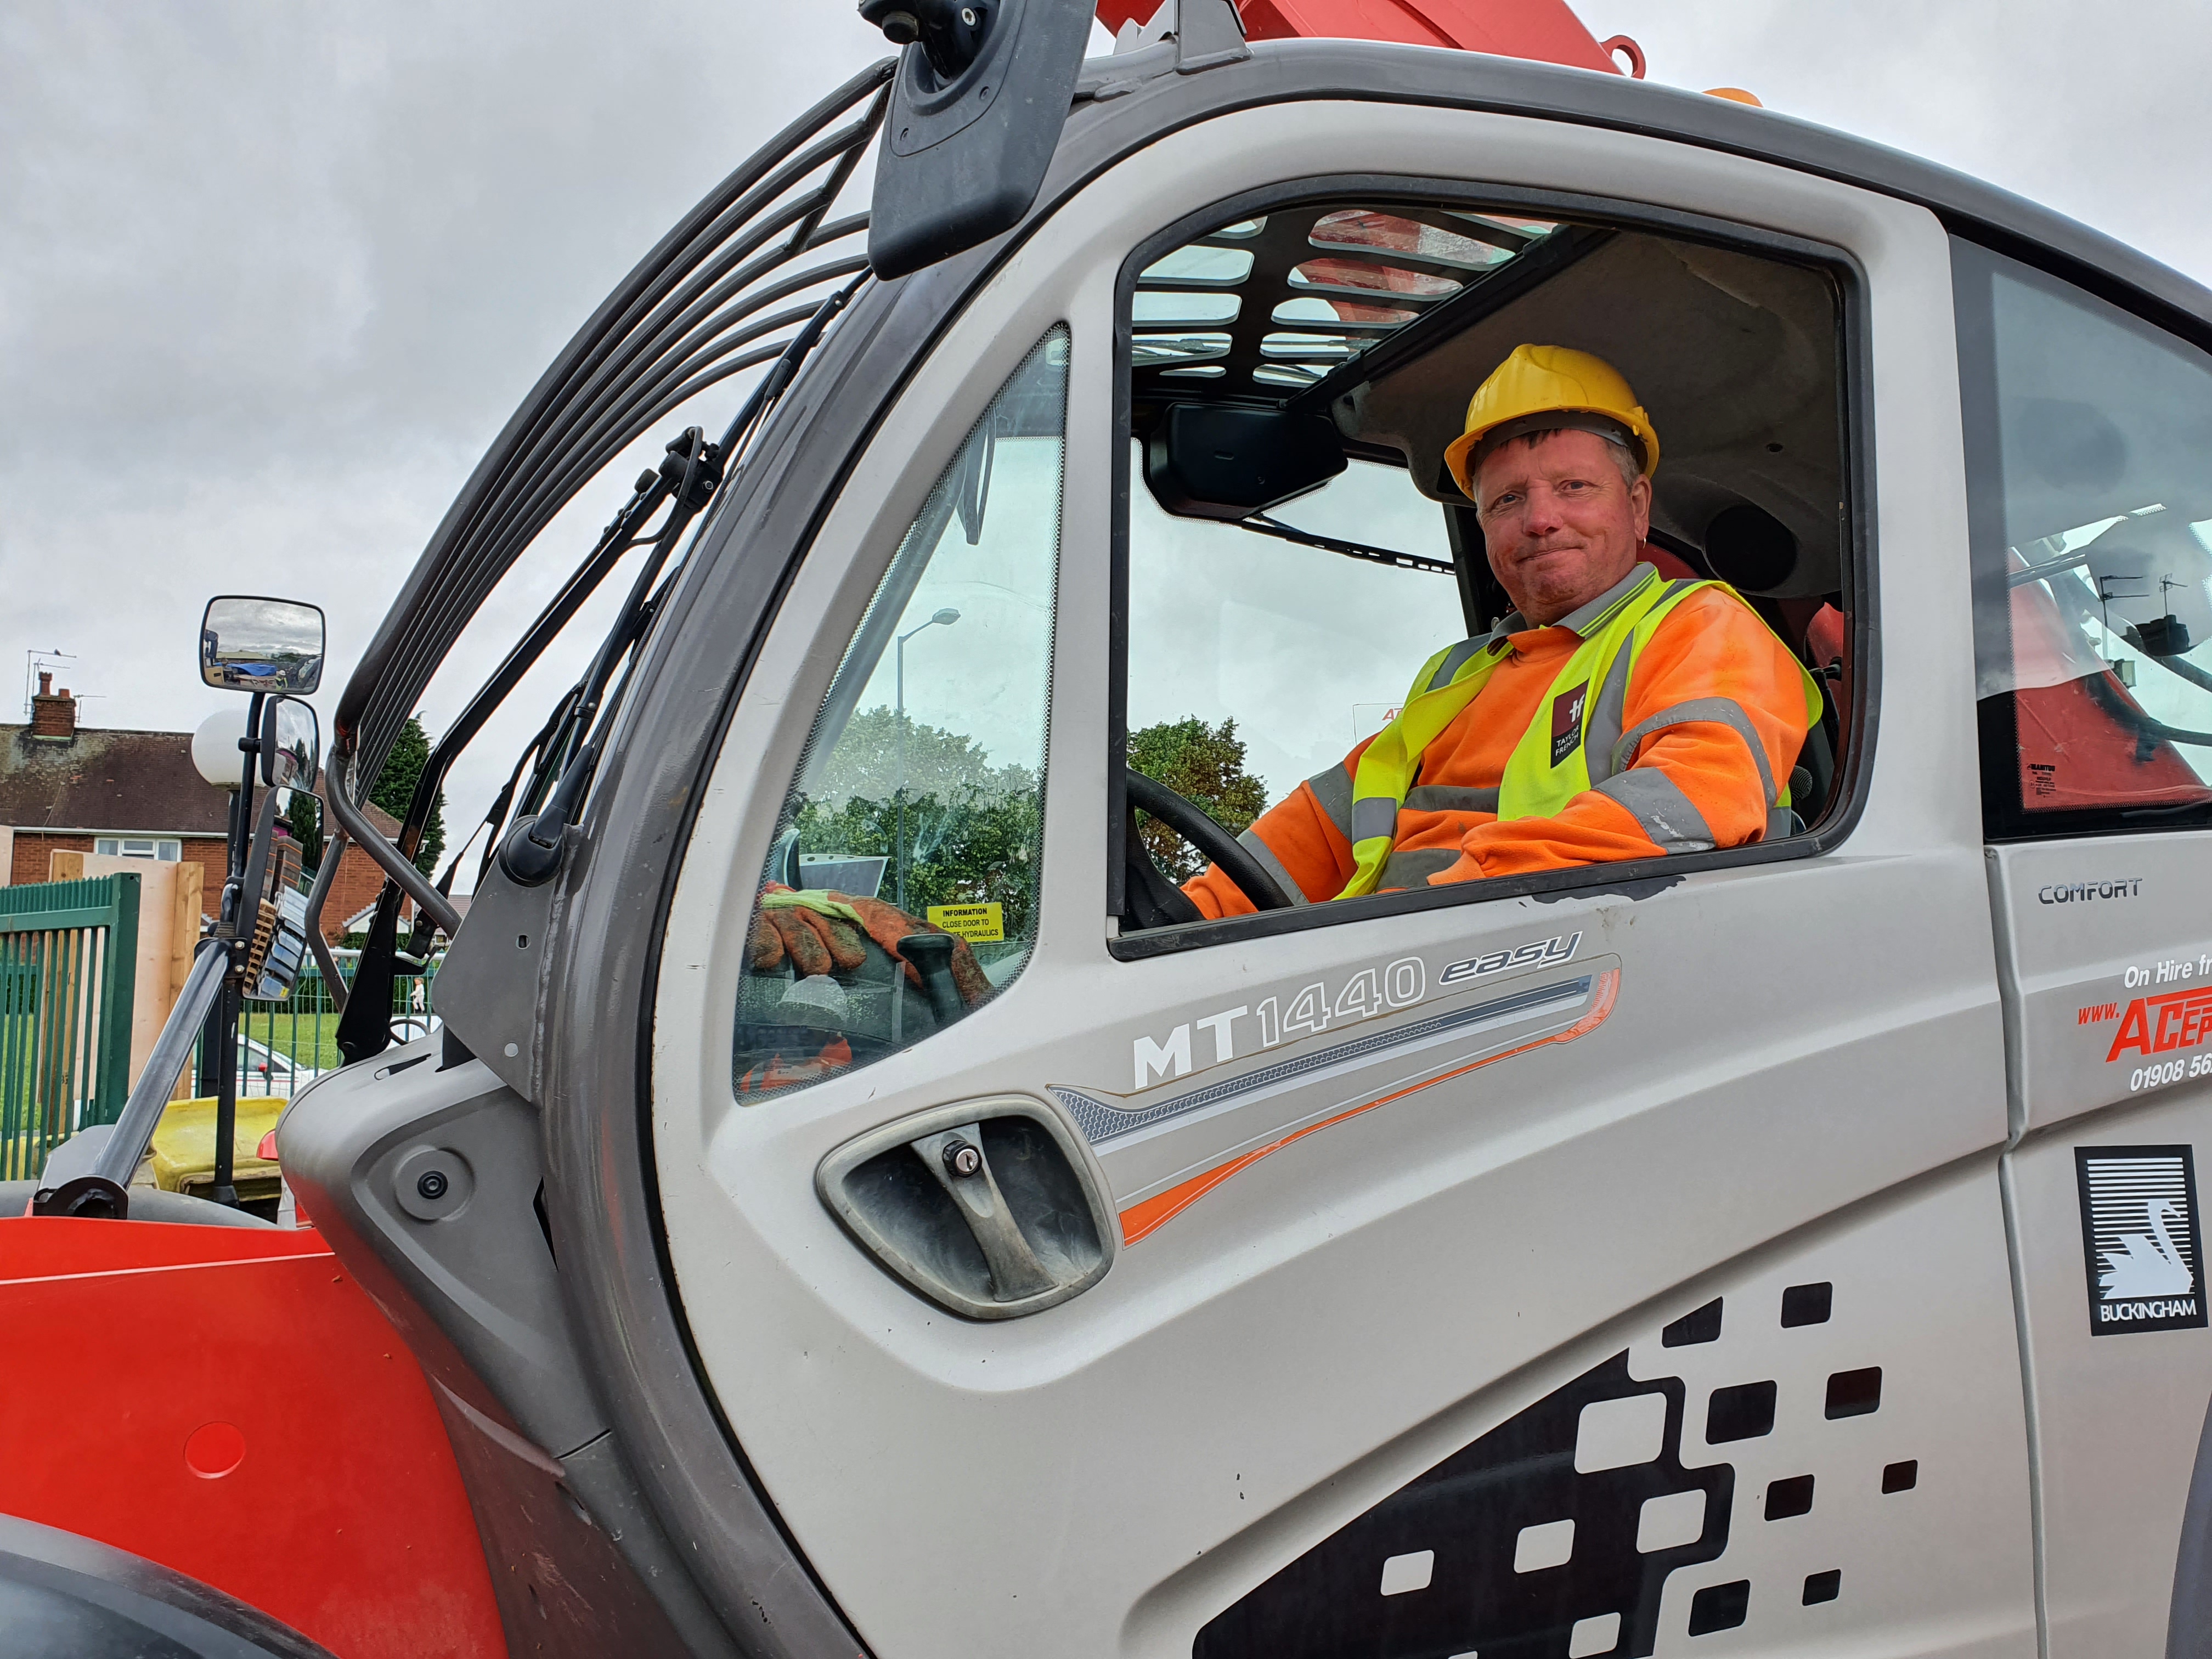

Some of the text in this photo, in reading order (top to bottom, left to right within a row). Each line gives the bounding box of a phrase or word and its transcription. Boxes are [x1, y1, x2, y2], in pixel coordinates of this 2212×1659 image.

[1555, 731, 1579, 757] FRENCH
[1556, 725, 1579, 747] TAYLOR
[2038, 877, 2143, 904] COMFORT
[942, 920, 962, 928] CLOSE
[963, 919, 980, 927] DOOR
[943, 907, 988, 917] INFORMATION
[962, 929, 998, 938] HYDRAULICS
[1438, 930, 1583, 986] easy
[2124, 966, 2150, 989] On
[2155, 960, 2193, 984] Hire
[2130, 1052, 2212, 1092] 01908 56
[2100, 1299, 2198, 1322] BUCKINGHAM
